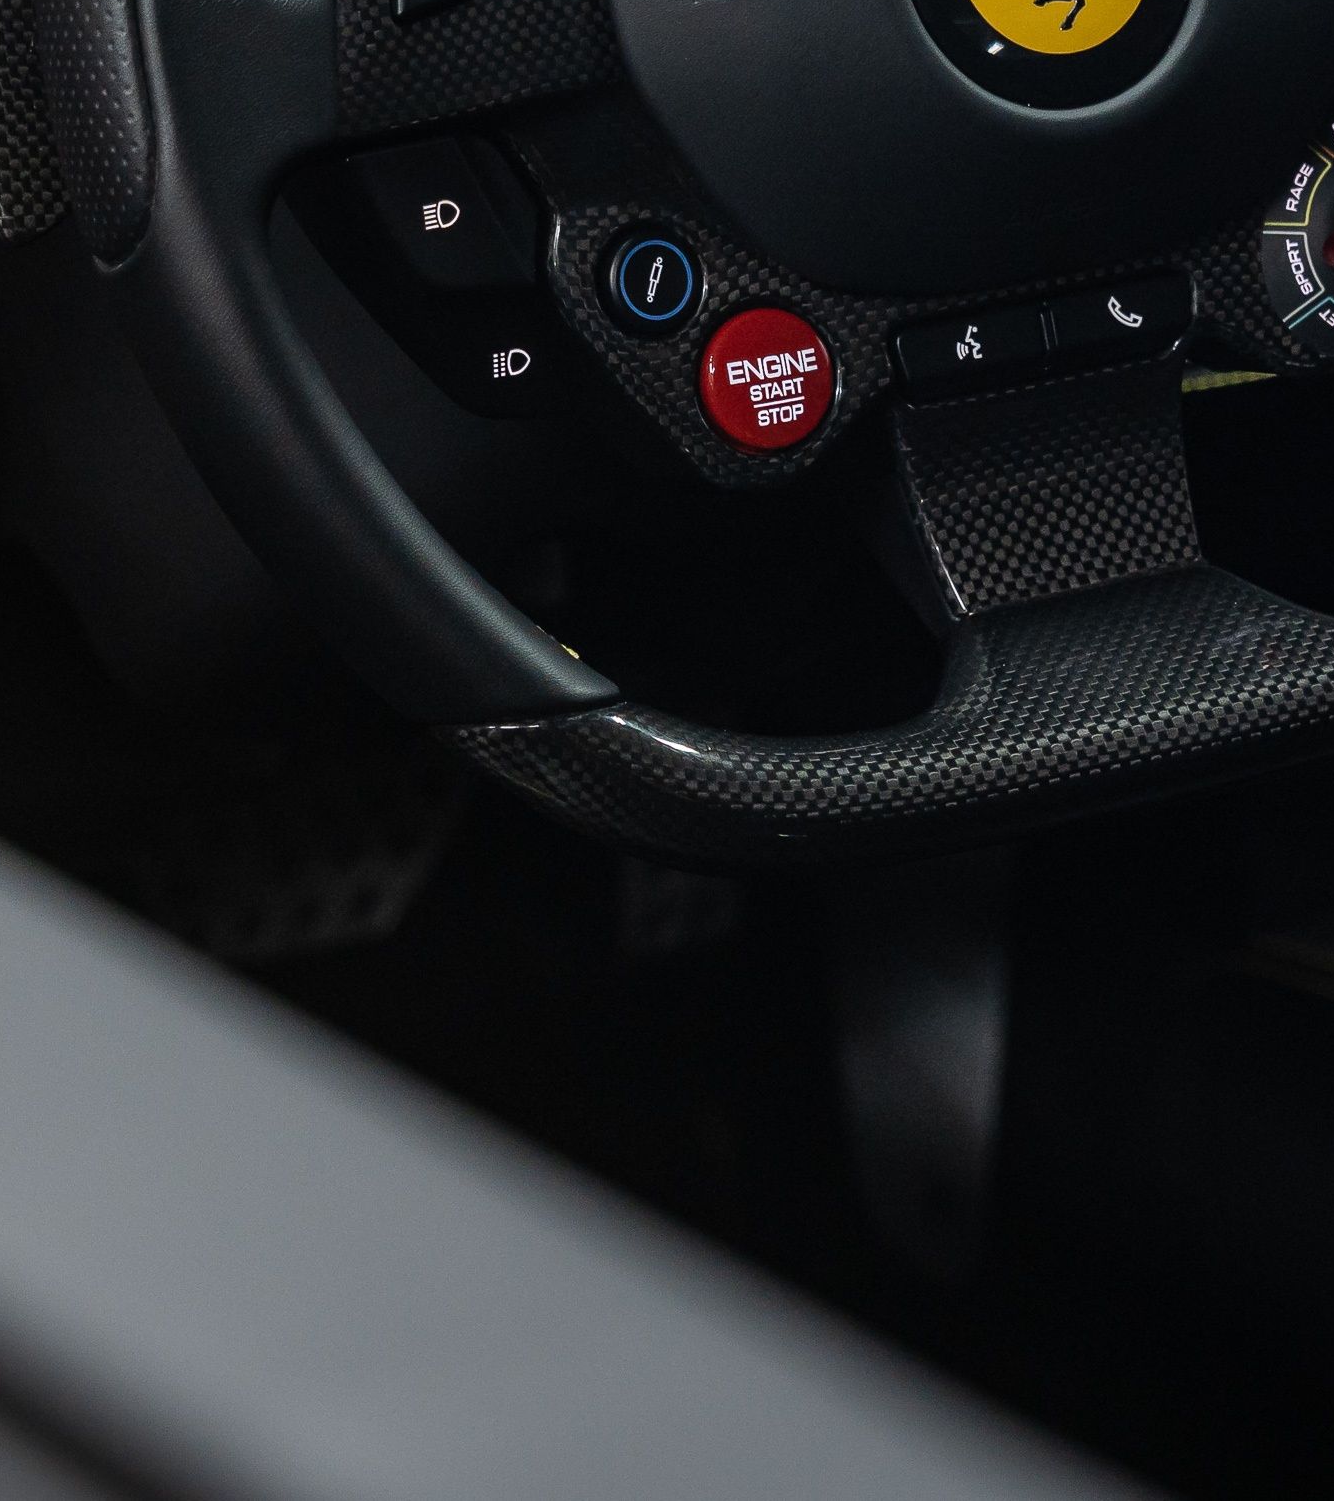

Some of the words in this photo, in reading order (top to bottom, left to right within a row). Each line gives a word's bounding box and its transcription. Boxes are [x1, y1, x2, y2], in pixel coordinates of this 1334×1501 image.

[1285, 163, 1315, 212] RACE
[1285, 239, 1314, 296] SPORT
[726, 347, 818, 386] ENGINE
[749, 377, 804, 402] START
[757, 403, 804, 427] STOP
